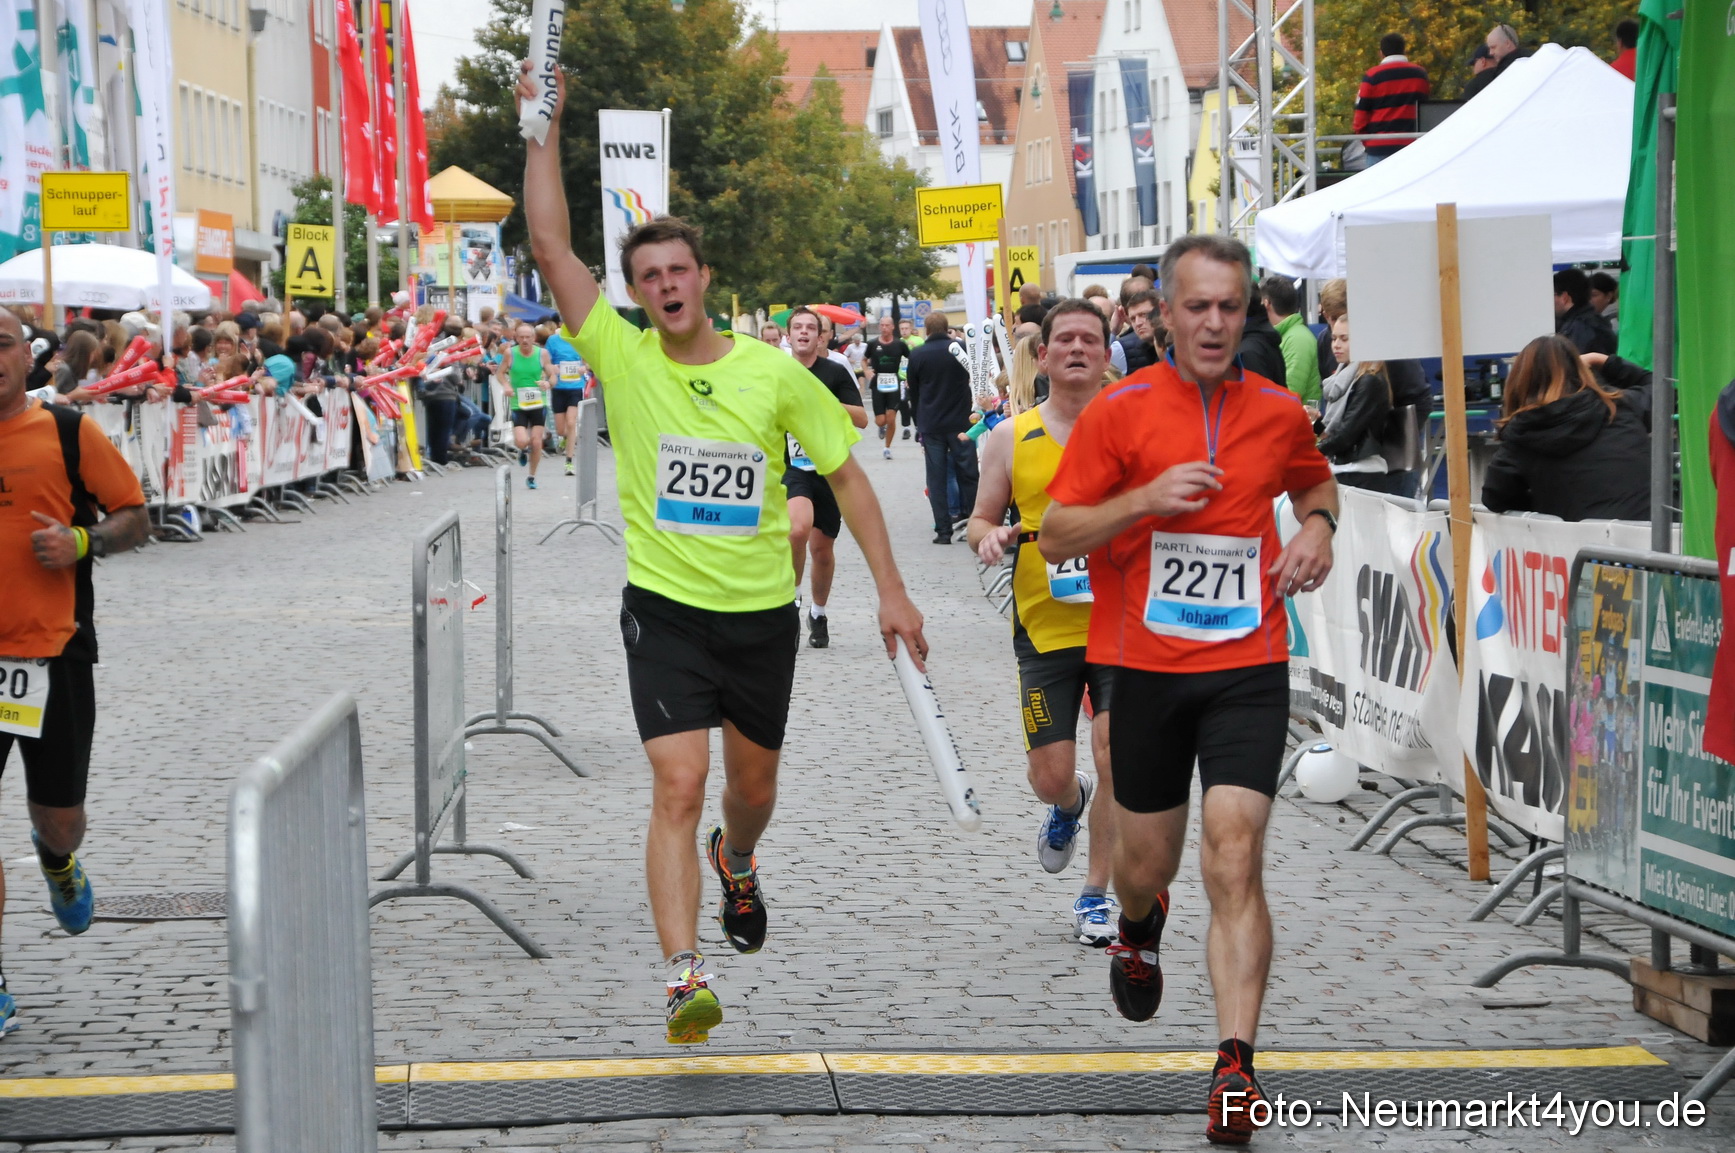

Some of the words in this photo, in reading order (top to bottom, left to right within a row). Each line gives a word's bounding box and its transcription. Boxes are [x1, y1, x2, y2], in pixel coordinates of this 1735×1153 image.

[538, 8, 563, 122] Laufsport
[46, 188, 123, 202] Schnupper-
[73, 205, 98, 216] lauf
[923, 202, 998, 216] Schnupper-
[949, 217, 974, 230] lauf
[293, 227, 329, 241] Block
[296, 246, 323, 280] A
[1008, 249, 1035, 261] lock
[1009, 267, 1026, 292] A
[0, 288, 16, 298] udi
[20, 289, 36, 298] BKK
[525, 392, 535, 401] 99
[660, 442, 695, 457] PARTL
[697, 449, 748, 461] Neumarkt
[666, 459, 755, 501] 2529
[691, 506, 722, 523] Max
[1154, 541, 1193, 554] PARTL
[1195, 545, 1244, 558] Neumarkt
[1161, 557, 1246, 601] 2271
[1176, 608, 1229, 626] Johann
[1675, 610, 1723, 648] Event-Leit-S
[0, 706, 20, 721] ian
[1029, 692, 1049, 723] Run!
[1648, 701, 1686, 754] Mehr
[1647, 766, 1670, 818] für
[1671, 774, 1689, 825] Ihr
[1644, 862, 1665, 896] Miet
[1666, 869, 1674, 899] &
[1675, 872, 1705, 910] Service
[1706, 883, 1728, 918] Line:
[1728, 890, 1735, 921] 0
